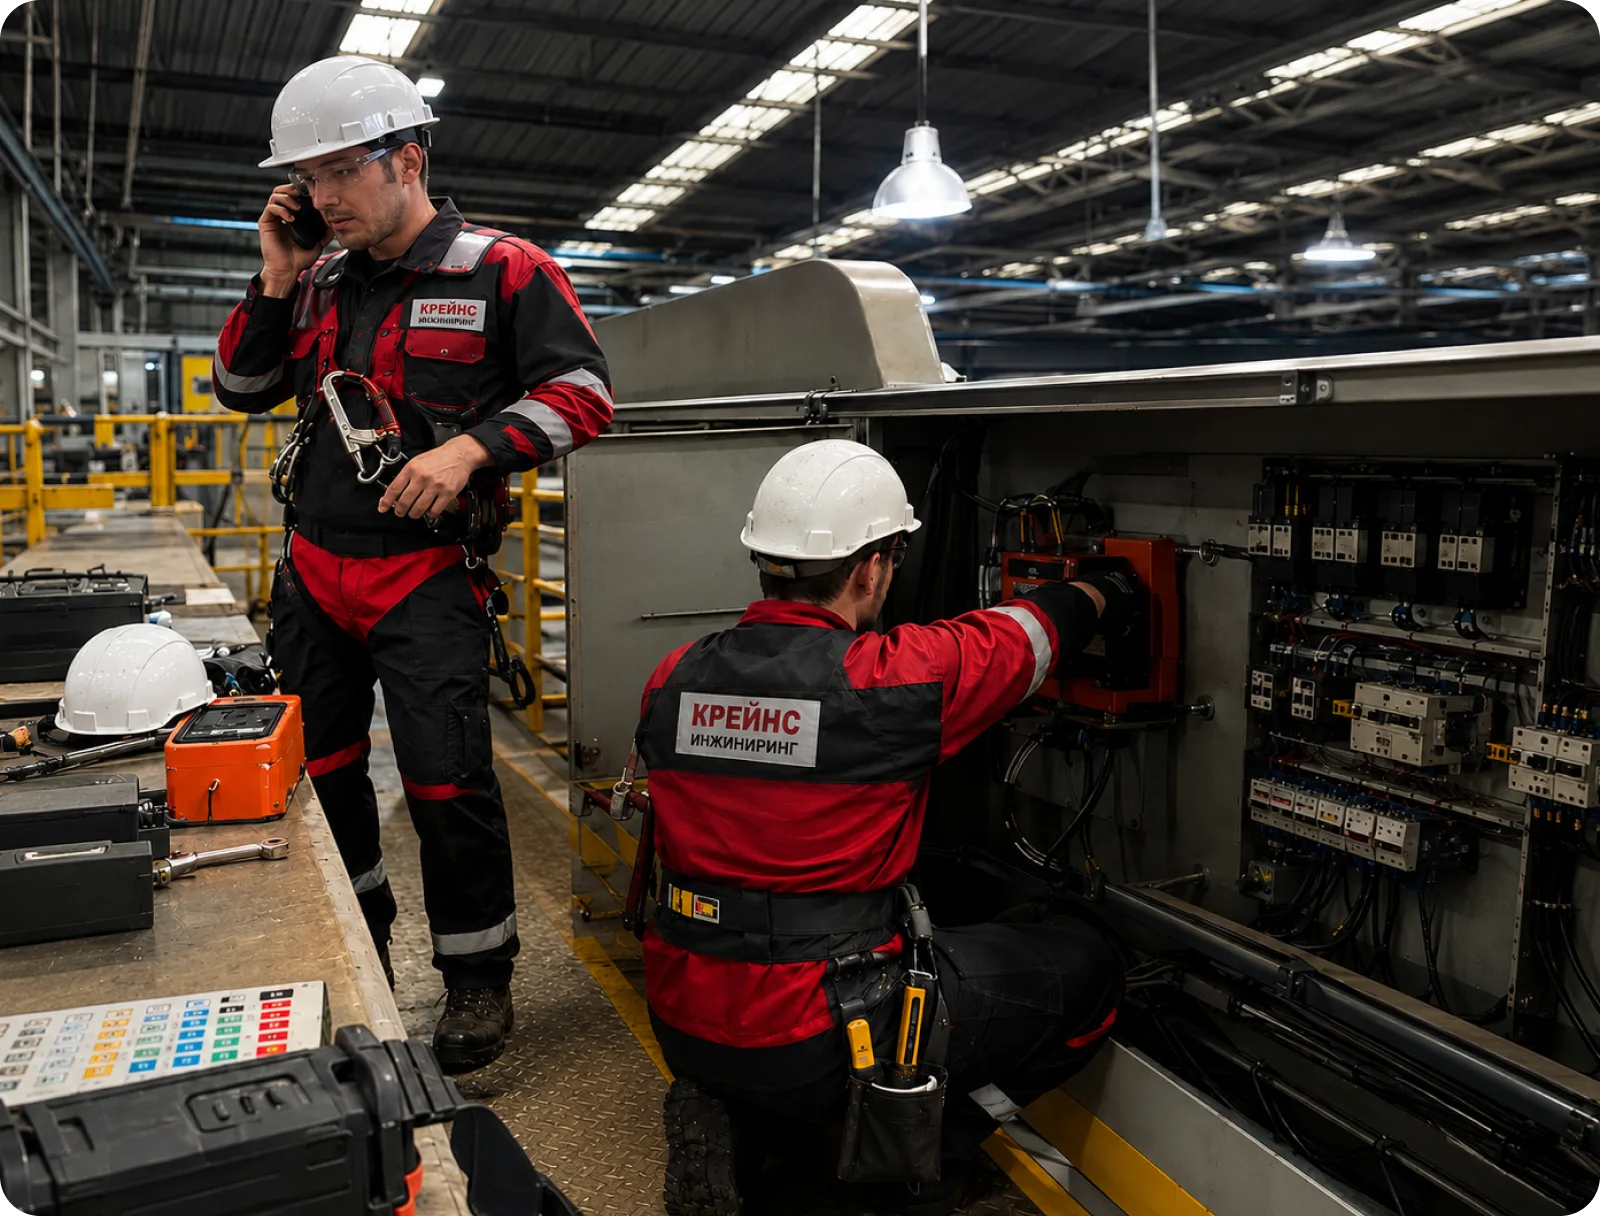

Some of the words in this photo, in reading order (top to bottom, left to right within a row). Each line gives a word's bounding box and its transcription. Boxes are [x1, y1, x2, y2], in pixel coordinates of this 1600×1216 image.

[420, 301, 477, 316] КРЕЙНС
[691, 701, 801, 735] КРЕЙНС
[690, 733, 798, 755] ИНЖИНИРИНГ
